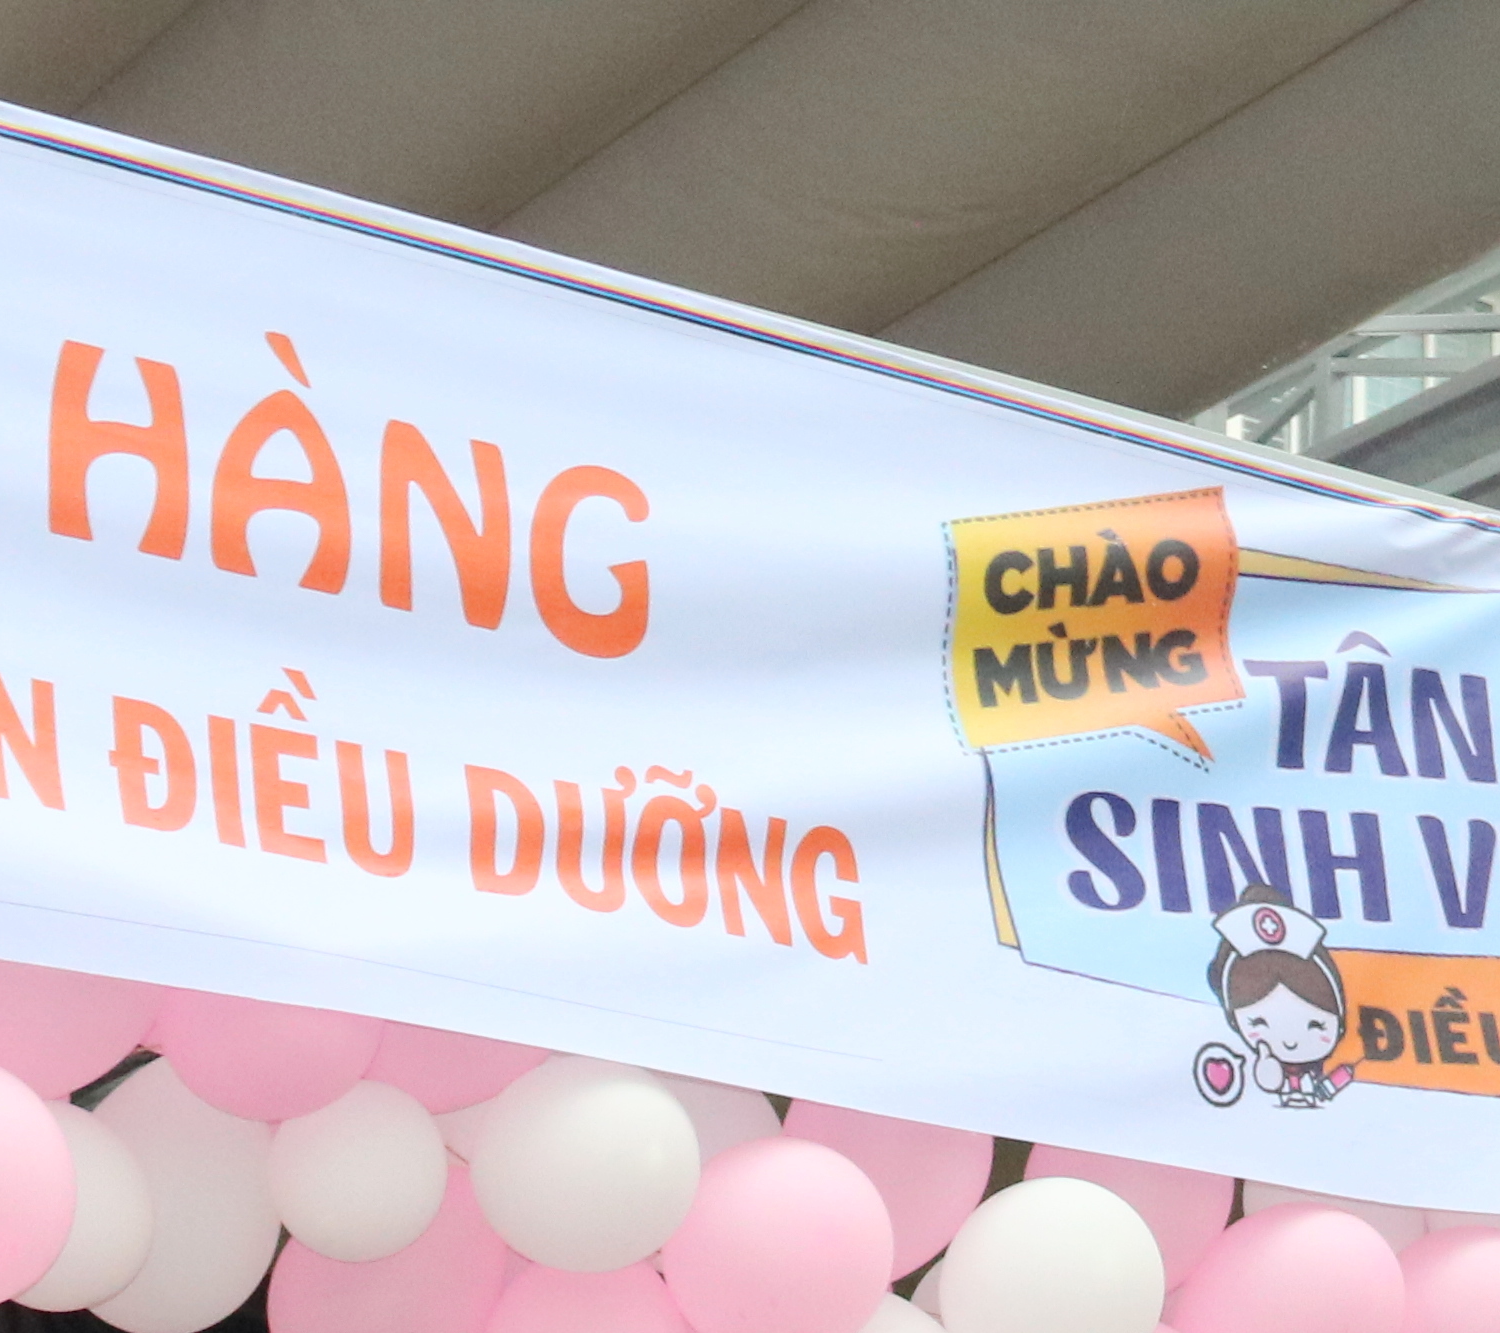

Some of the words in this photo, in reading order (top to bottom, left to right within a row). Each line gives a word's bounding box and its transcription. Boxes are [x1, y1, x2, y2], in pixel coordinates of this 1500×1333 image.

[47, 331, 652, 659] HÀNG
[982, 528, 1201, 617] CHÀO
[974, 626, 1210, 709] MỪNG
[1244, 631, 1498, 785] TÂN
[108, 666, 416, 879] ĐIỀU
[463, 761, 869, 965] DƯỠNG
[1063, 789, 1394, 925] SINH
